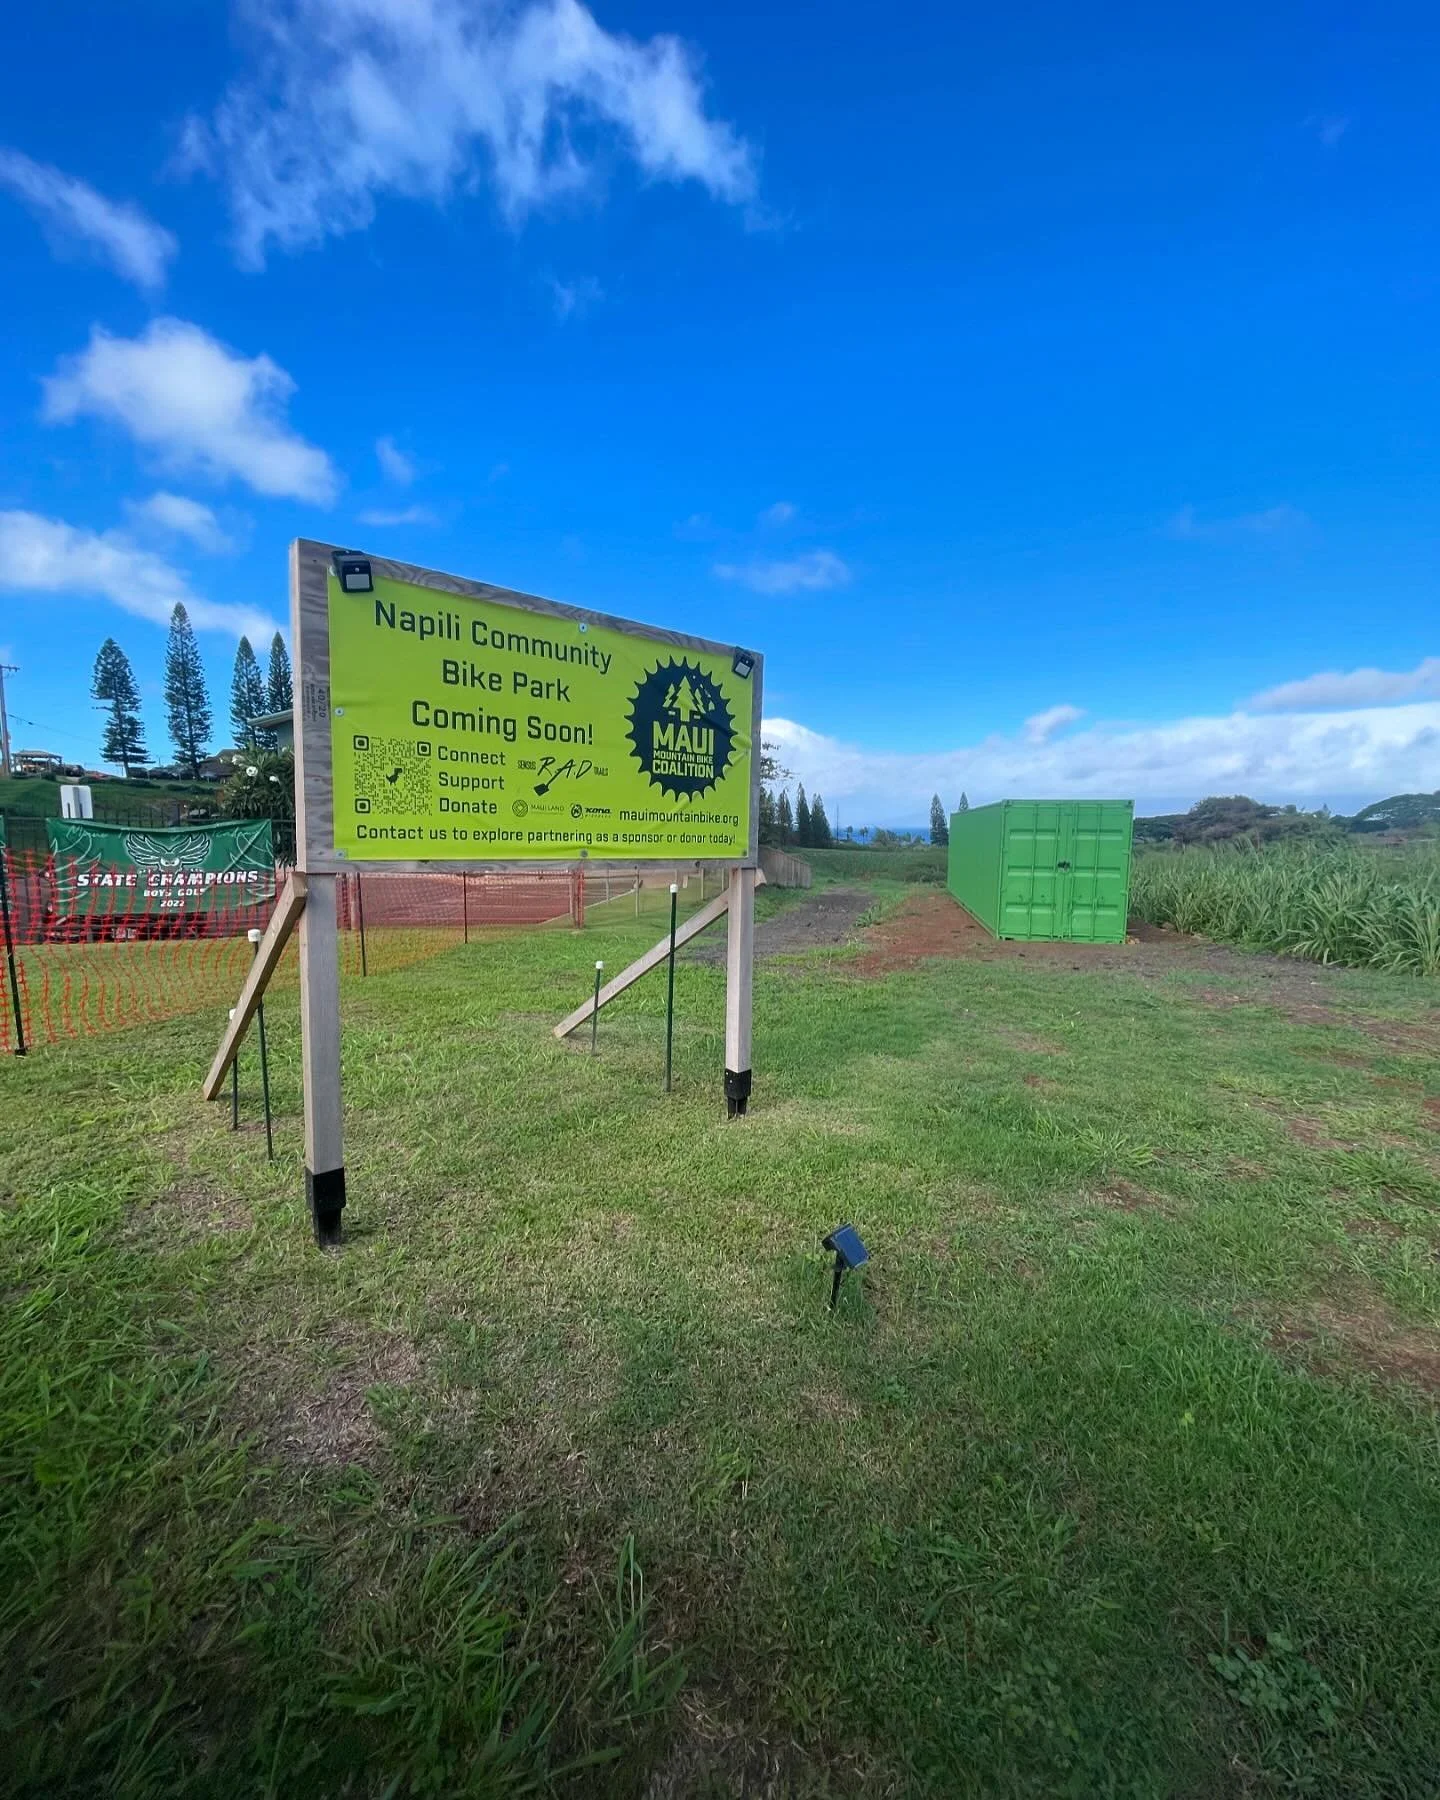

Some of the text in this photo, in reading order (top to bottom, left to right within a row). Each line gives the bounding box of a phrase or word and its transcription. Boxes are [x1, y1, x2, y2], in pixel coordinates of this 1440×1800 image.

[376, 600, 613, 674] Napili Community
[443, 659, 570, 702] Bike Park
[411, 700, 592, 745] Coming Soon!
[652, 721, 714, 755] MAUI
[438, 746, 505, 765] Connect
[653, 751, 713, 764] MOUNTAIN BIKE
[652, 760, 714, 778] COALITION
[439, 772, 504, 791] Support
[440, 798, 497, 814] Donate
[620, 808, 738, 827] mauimountainbike.org
[357, 825, 735, 845] Contact us to explore partnering as a sponsor or donor today!
[76, 874, 138, 887] STATE
[147, 870, 258, 887] CHAMPIONS
[143, 889, 172, 897] BOYS
[160, 899, 185, 908] 2022
